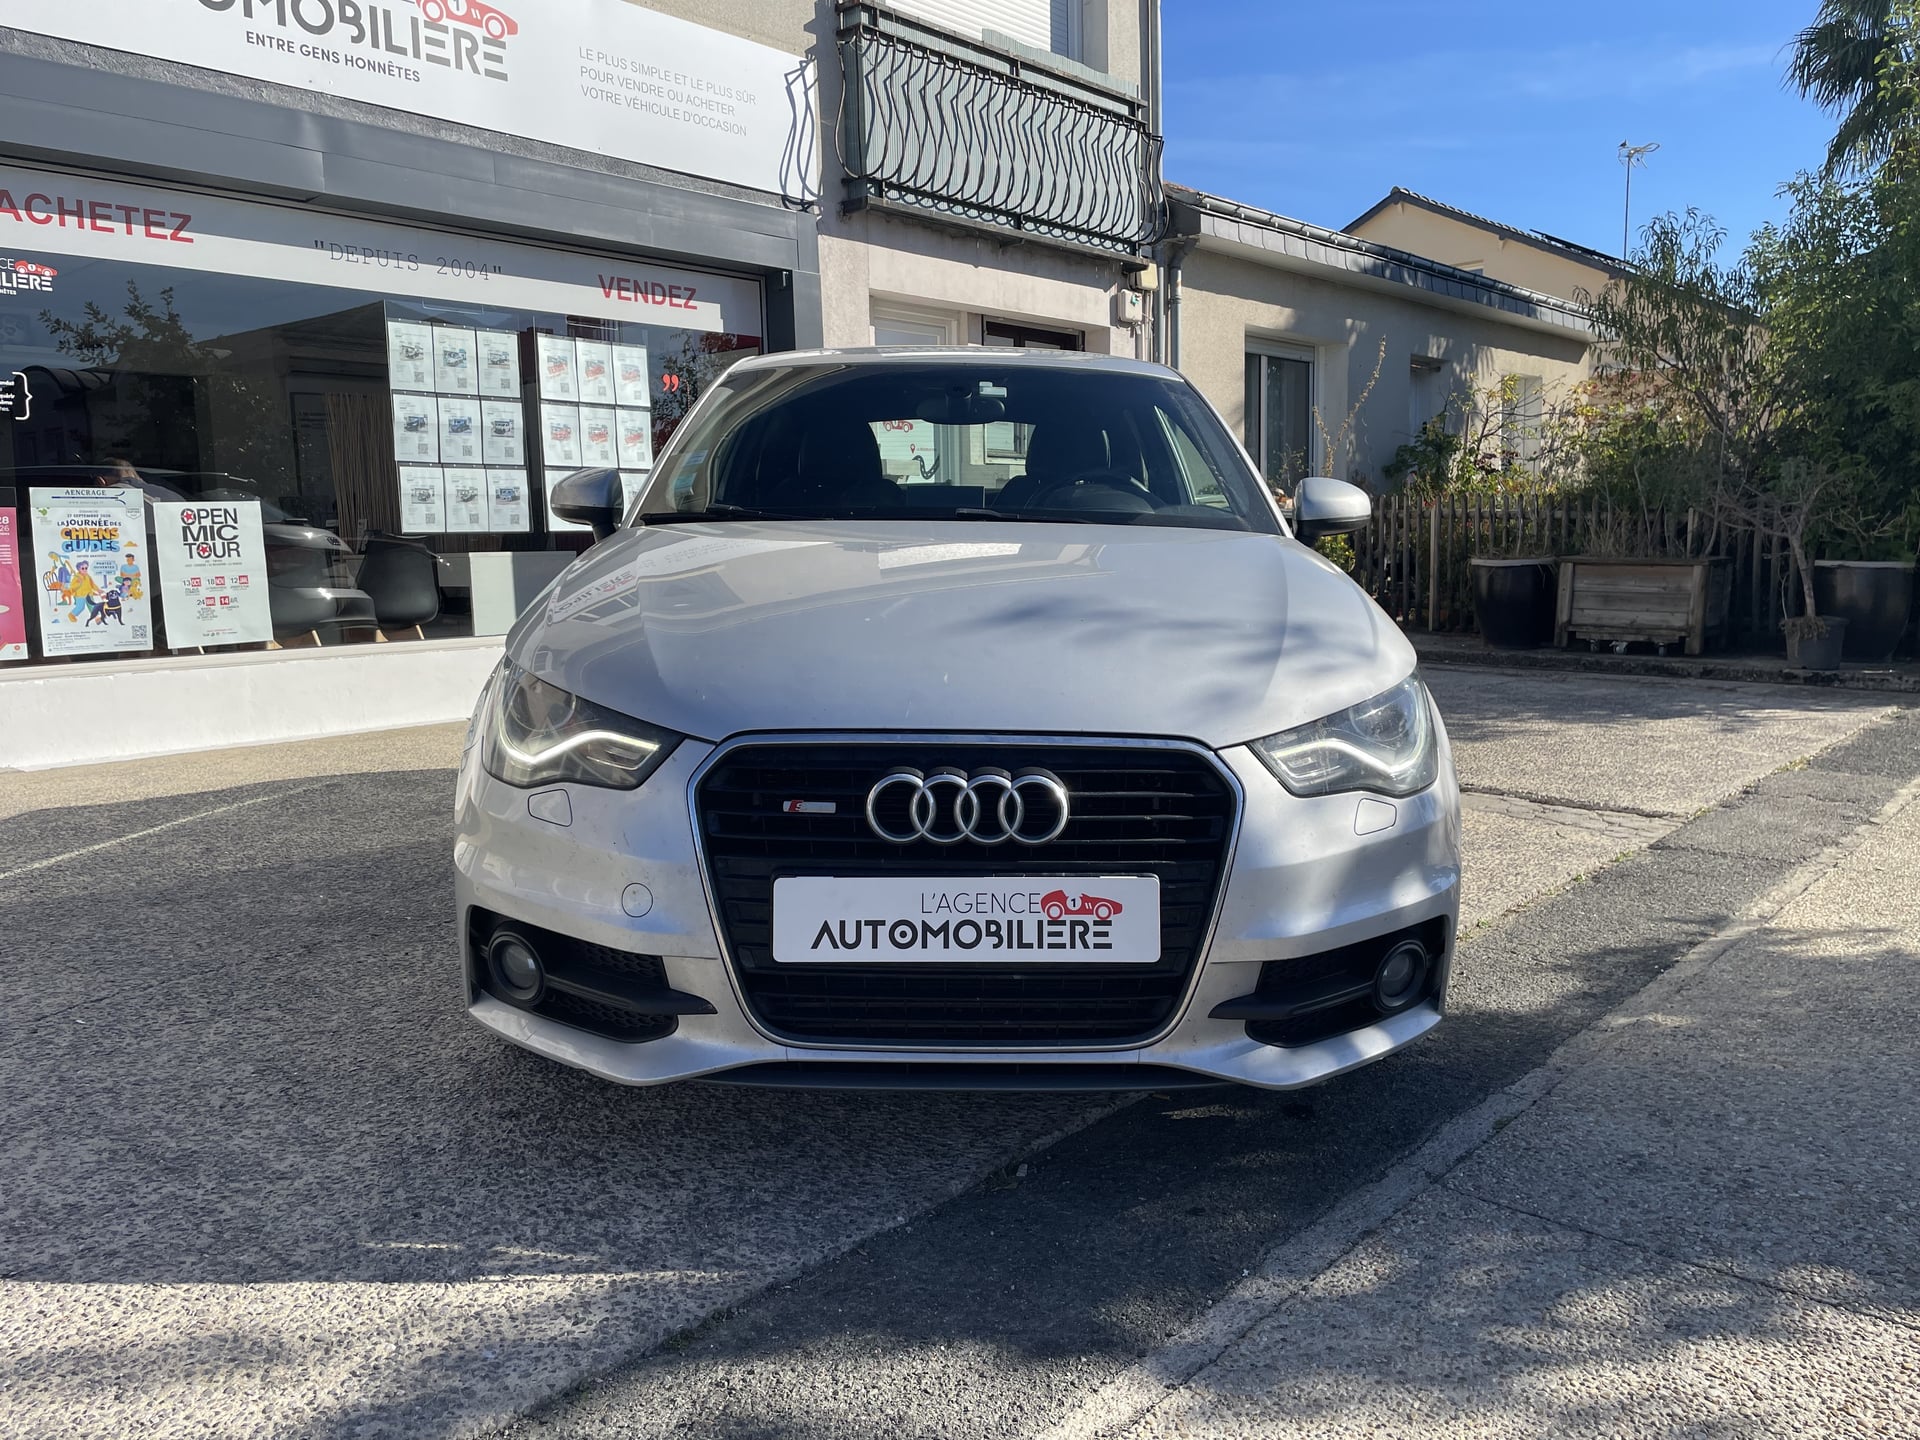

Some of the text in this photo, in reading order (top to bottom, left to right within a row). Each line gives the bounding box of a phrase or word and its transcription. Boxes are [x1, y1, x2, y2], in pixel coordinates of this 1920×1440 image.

[198, 0, 508, 82] MOBILIERE
[246, 31, 420, 82] ENTRE GENS HONNÊTES
[579, 46, 756, 105] LE PLUS SIMPLE ET LE PLUS SÛR
[580, 66, 735, 116] POUR VENDRE OU ACHETER
[581, 84, 747, 136] VOTRE VÉHICULE D'OCCASION
[0, 189, 194, 244] ACHETEZ
[597, 274, 698, 311] VENDEZ
[0, 516, 9, 524] 8
[65, 518, 109, 527] JOURNÉE
[180, 508, 238, 525] OPEN
[60, 527, 120, 540] CHIENS
[182, 524, 239, 542] MIC
[61, 539, 121, 553] GUIDES
[183, 541, 241, 559] TOUR
[220, 597, 229, 605] 14
[920, 892, 1042, 914] L'AGENCE
[810, 919, 1113, 950] AUTOMOBILIERE
